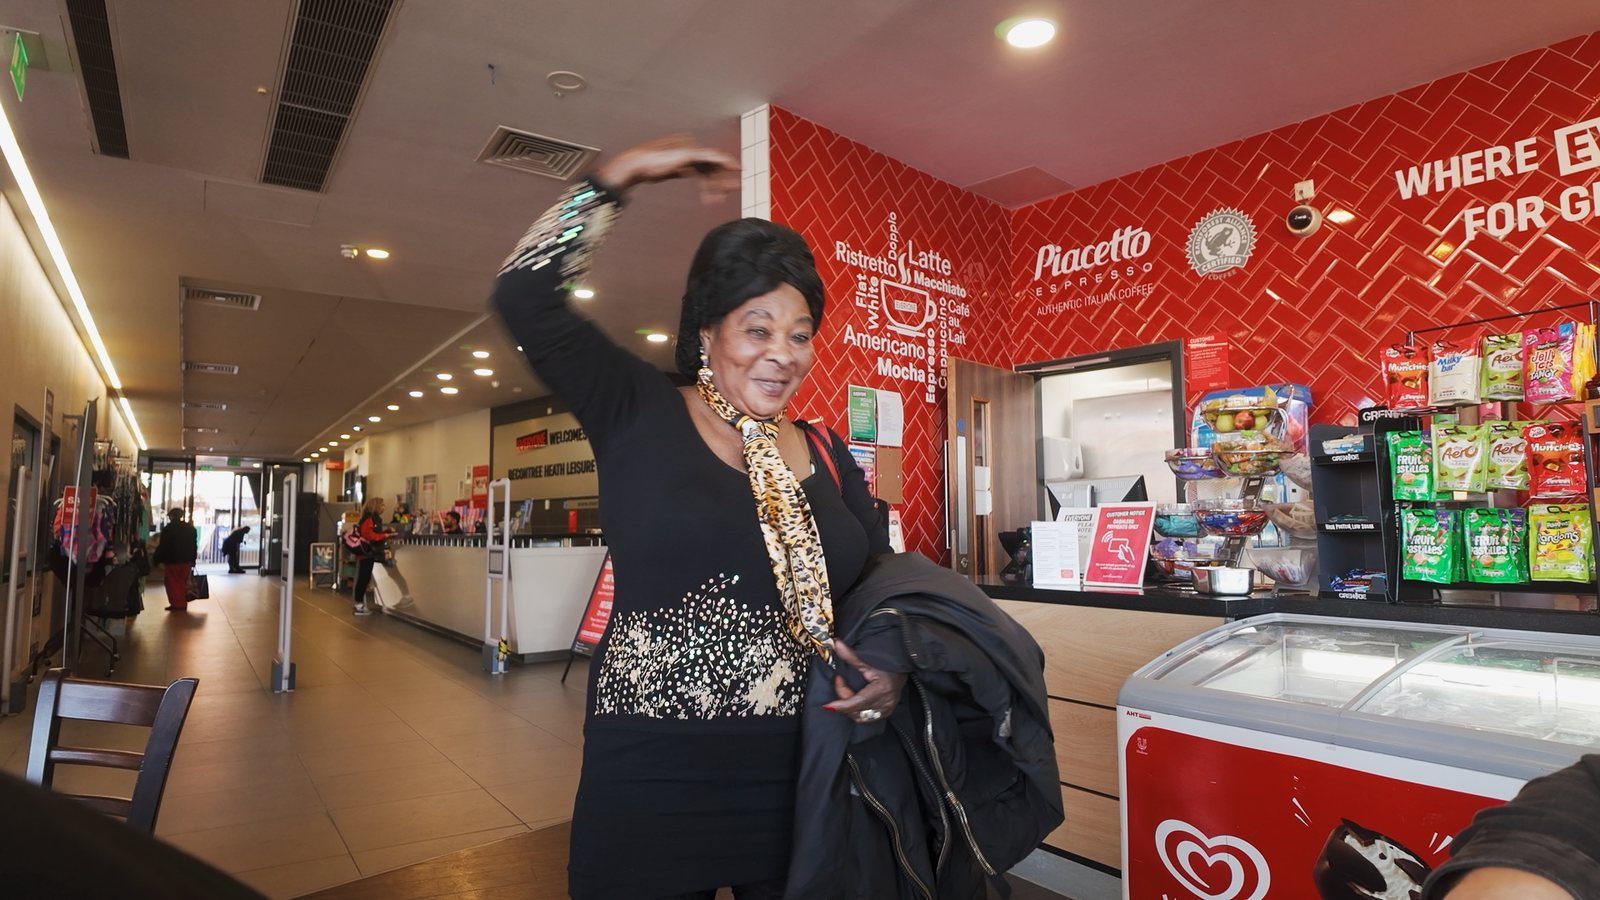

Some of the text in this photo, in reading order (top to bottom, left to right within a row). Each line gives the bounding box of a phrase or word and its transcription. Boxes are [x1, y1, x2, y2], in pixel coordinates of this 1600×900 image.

[1395, 137, 1539, 200] WHERE
[1464, 181, 1600, 241] FOR G
[888, 211, 897, 261] Doppio
[1225, 217, 1247, 243] ALLIANCE
[835, 241, 897, 278] Ristretto
[908, 240, 952, 276] Latte
[1034, 225, 1151, 281] Piacetto
[1201, 257, 1242, 272] CERTIFIED
[856, 273, 868, 308] Flat
[914, 270, 967, 298] Macchiato
[1036, 263, 1153, 297] ESPRESSO
[1208, 269, 1237, 280] COFFEE
[868, 276, 880, 330] White
[948, 300, 970, 317] Café
[1036, 283, 1154, 316] AUTHENTIC ITALIAN COFFEE
[948, 317, 959, 328] au
[949, 329, 967, 345] Lait
[843, 324, 926, 360] Americano
[938, 297, 949, 389] Cappuccino
[877, 357, 925, 383] Mocha
[925, 327, 936, 403] Espresso
[544, 463, 565, 477] HEATH
[567, 460, 596, 475] LEISURE
[1442, 446, 1479, 460] Aero
